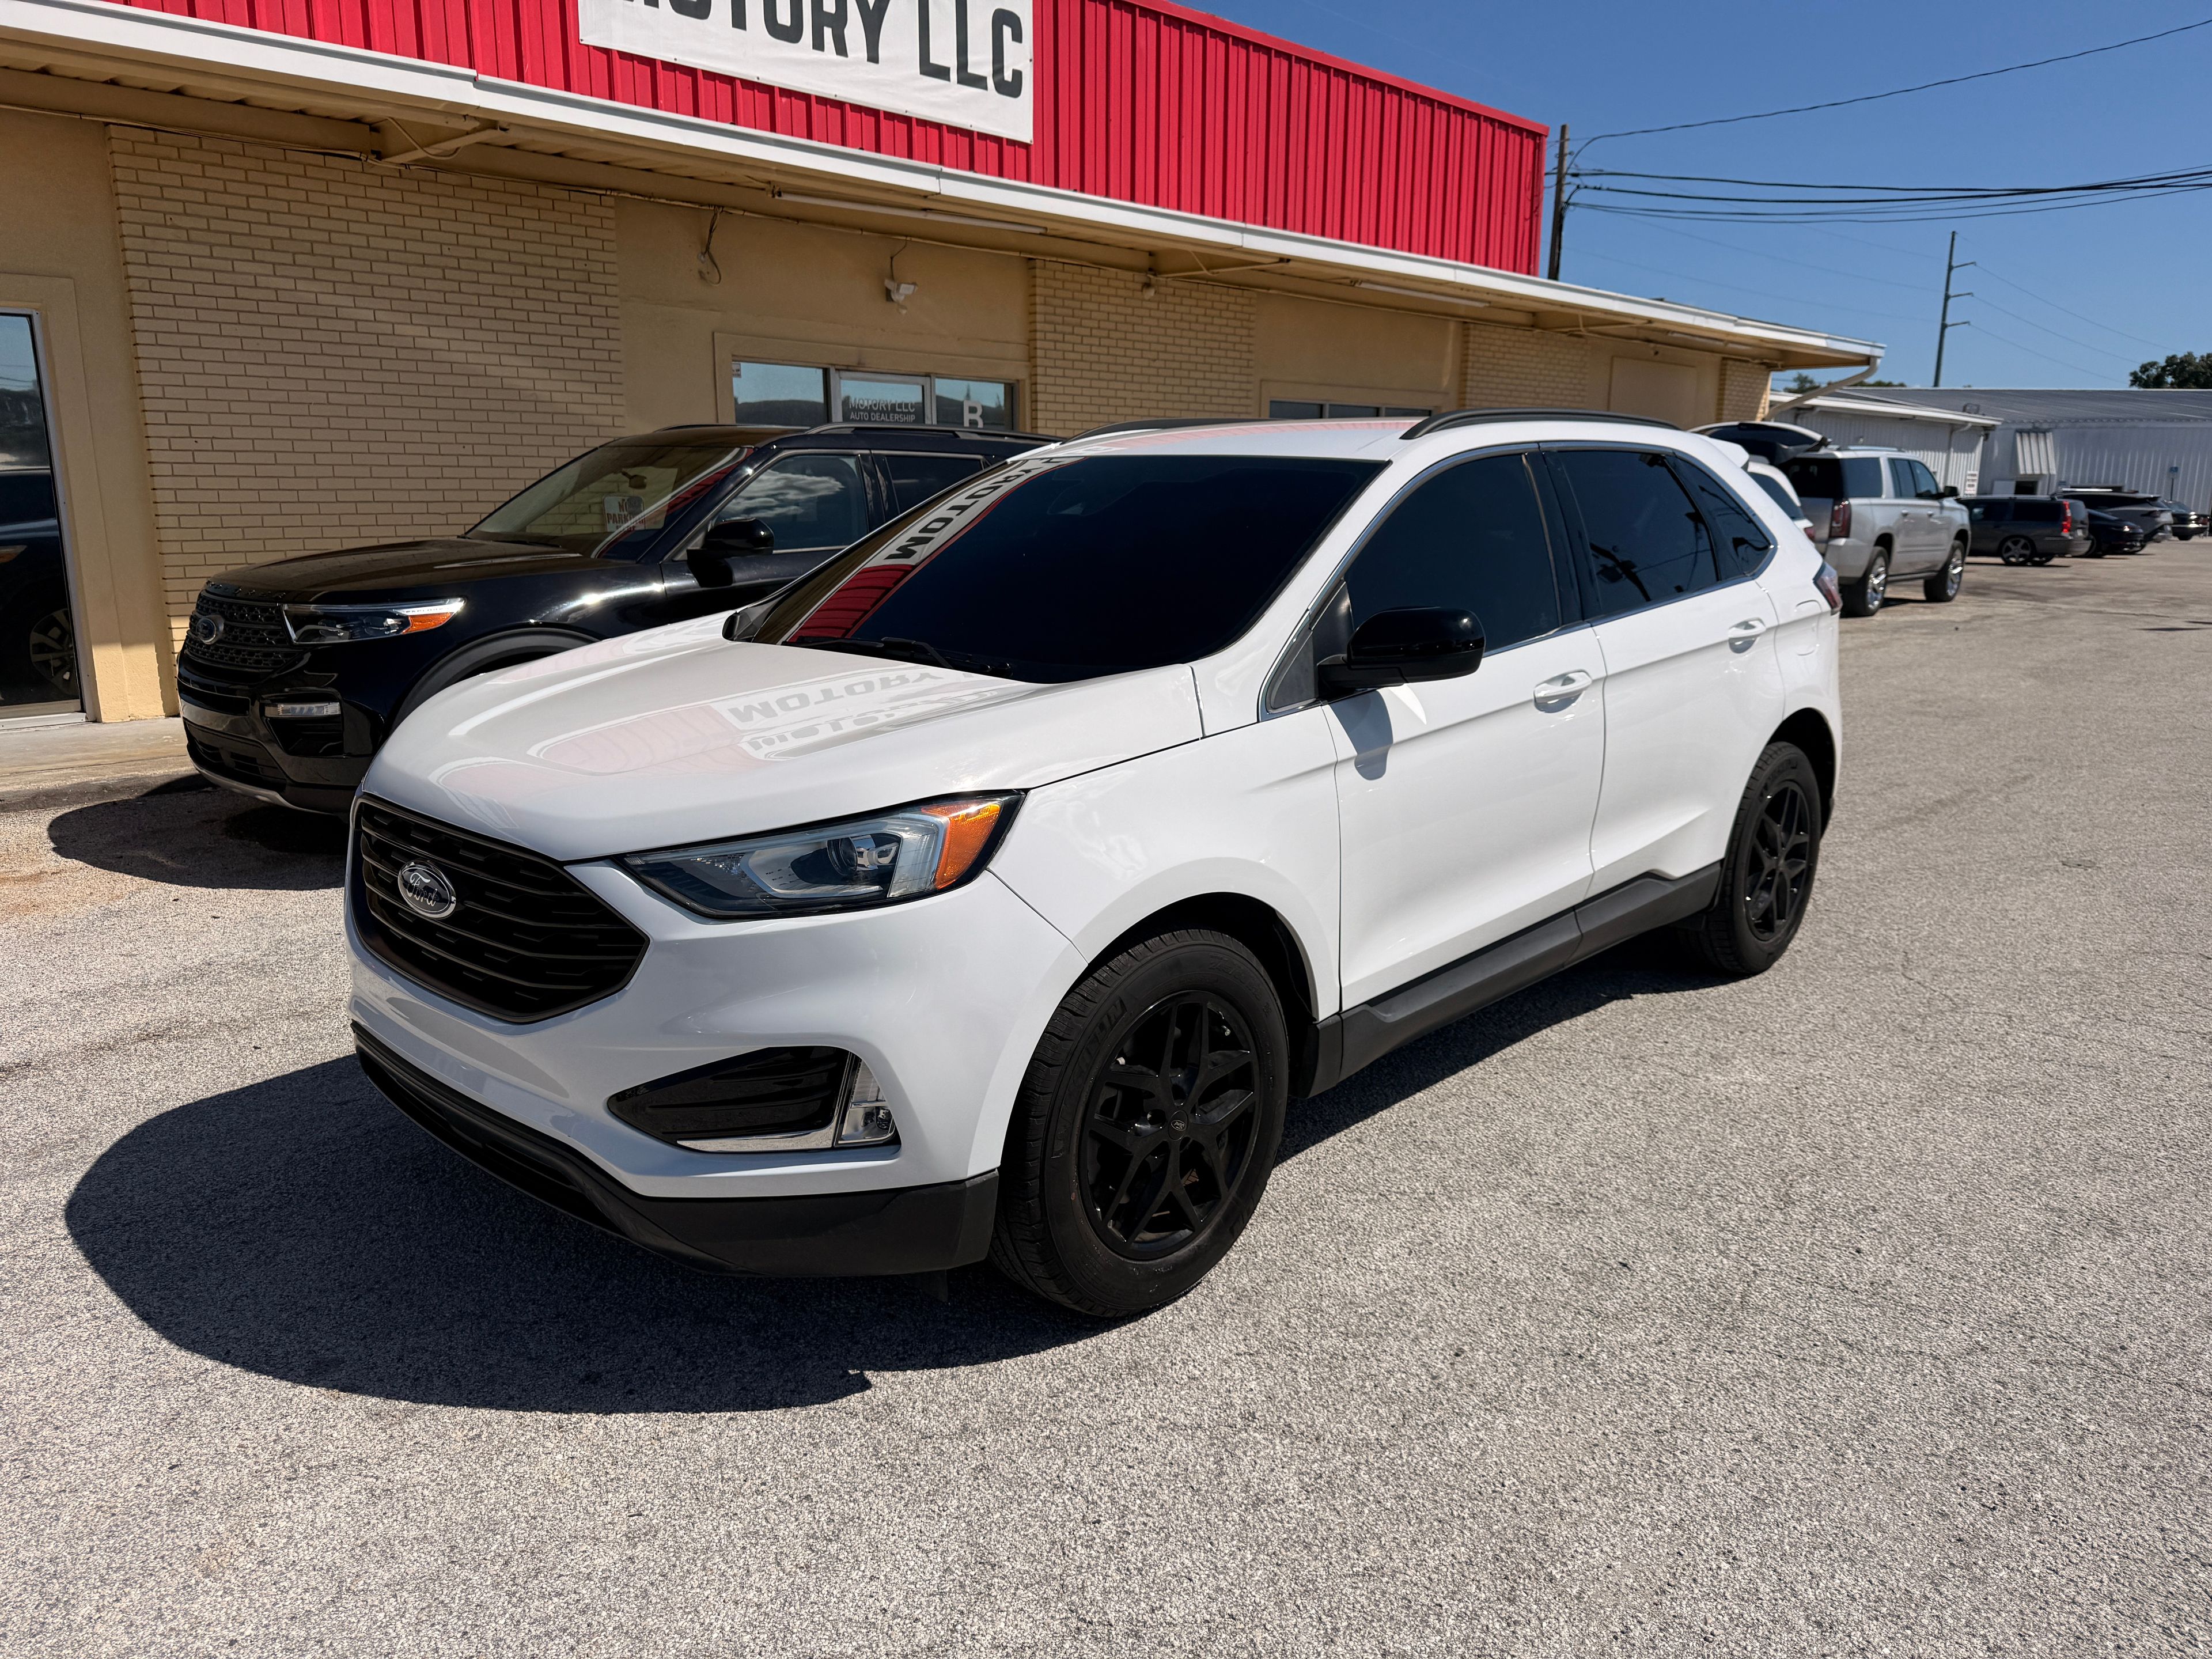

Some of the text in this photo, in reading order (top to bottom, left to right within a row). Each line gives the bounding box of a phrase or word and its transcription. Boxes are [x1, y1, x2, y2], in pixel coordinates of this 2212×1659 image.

[919, 0, 1022, 99] LLC
[849, 397, 915, 412] MOTORY LLC
[850, 411, 915, 423] AUTO DEALERSHIP
